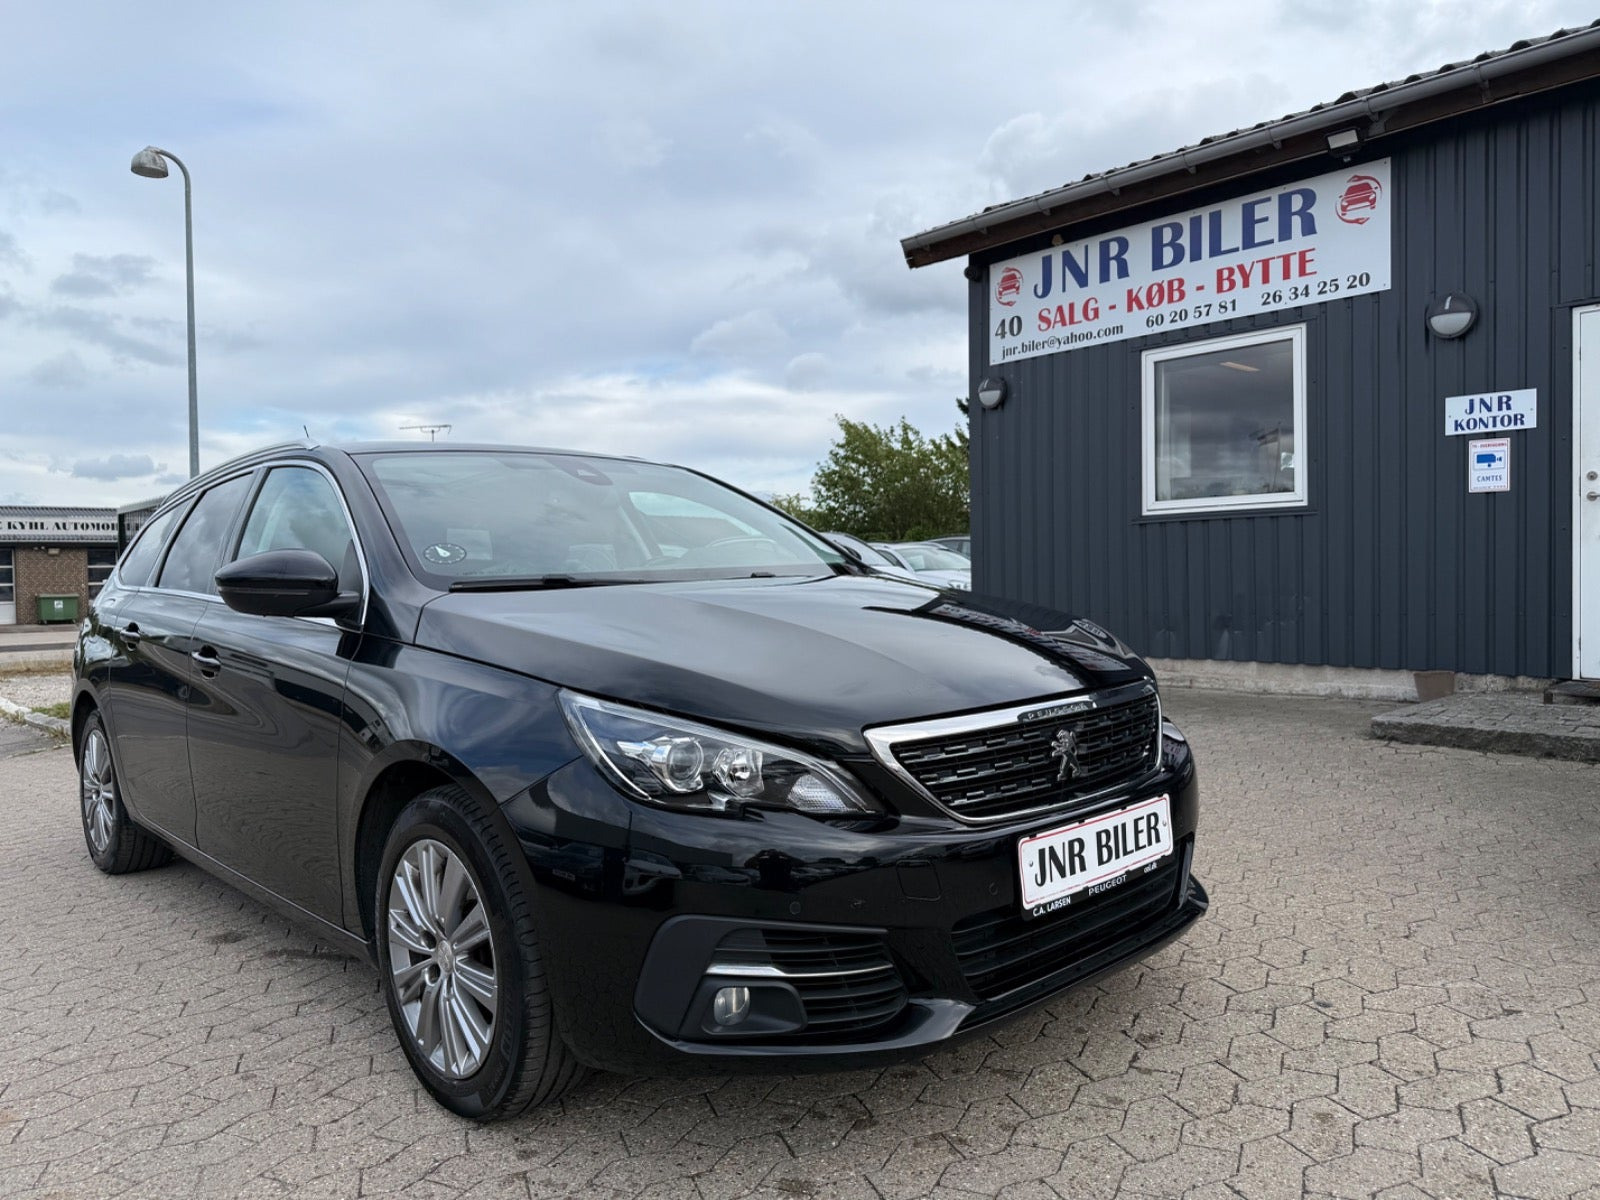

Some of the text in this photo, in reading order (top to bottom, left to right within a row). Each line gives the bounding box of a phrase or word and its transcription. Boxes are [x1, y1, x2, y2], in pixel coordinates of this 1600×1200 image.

[1033, 188, 1318, 299] JNR BILER
[1038, 297, 1100, 332] SALG
[1126, 277, 1186, 314] KØB
[1216, 248, 1318, 295] BYTTE
[1261, 272, 1371, 306] 26 34 25 20
[995, 315, 1023, 340] 40
[1145, 299, 1237, 329] 60 20 57 81
[1002, 324, 1124, 360] jnr.biler@yahoo.com
[1465, 395, 1512, 415] JNR
[1454, 413, 1525, 432] KONTOR
[1034, 811, 1161, 888] JNR BILER
[1088, 874, 1128, 896] PEUGEOT
[1046, 896, 1071, 912] LARSEN
